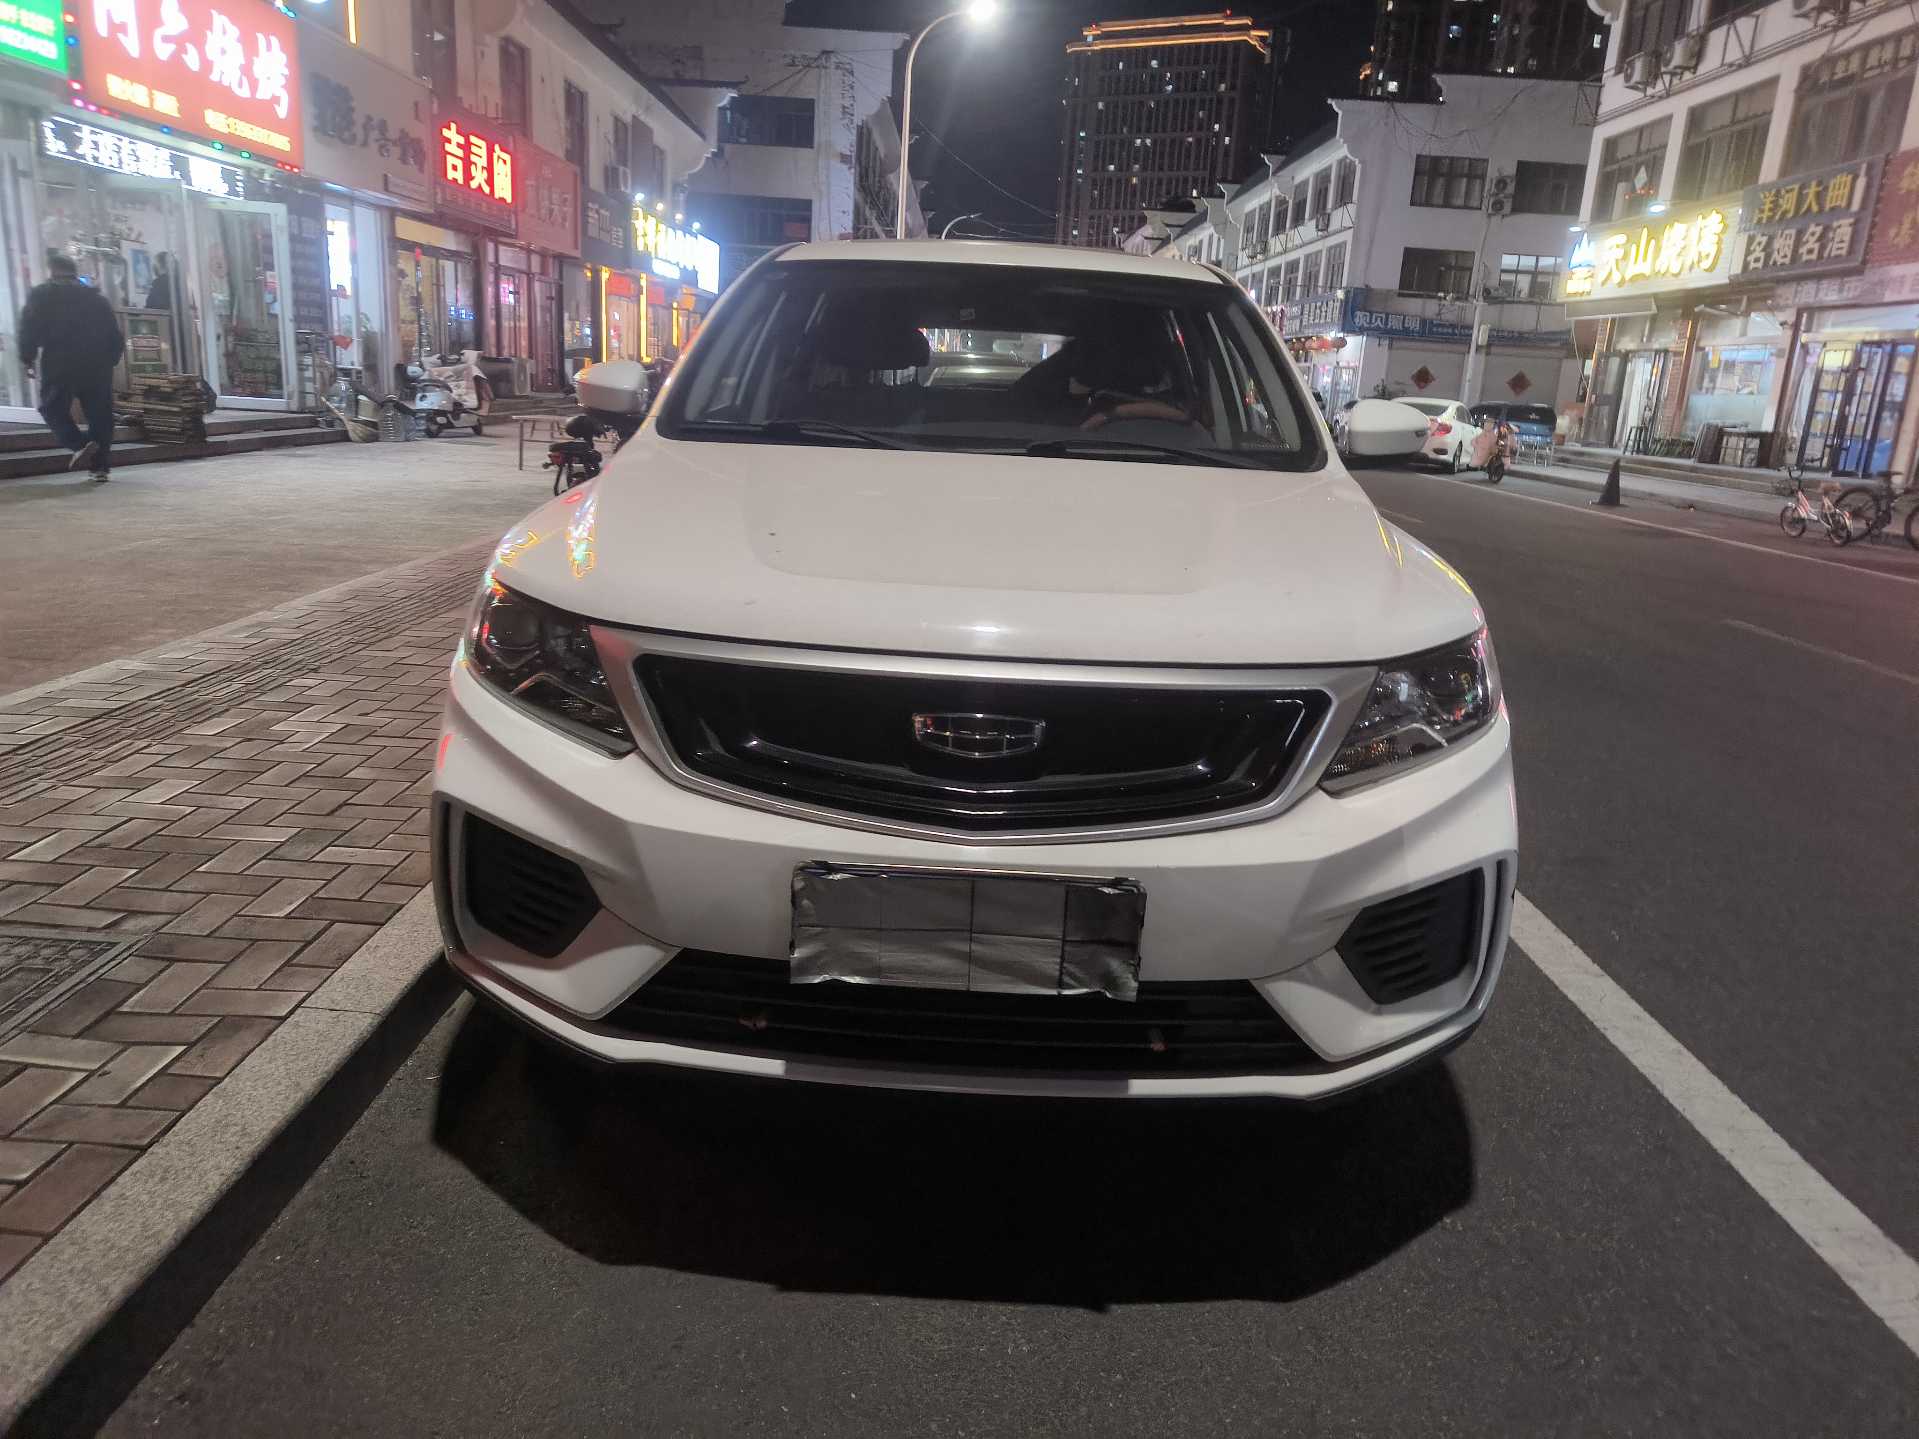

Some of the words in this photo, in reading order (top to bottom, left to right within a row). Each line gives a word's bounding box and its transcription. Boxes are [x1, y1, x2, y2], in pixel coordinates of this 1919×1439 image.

[1754, 172, 1855, 224] 洋河大曲
[1599, 209, 1726, 288] 天山烧烤
[1747, 217, 1857, 272] 名烟名酒
